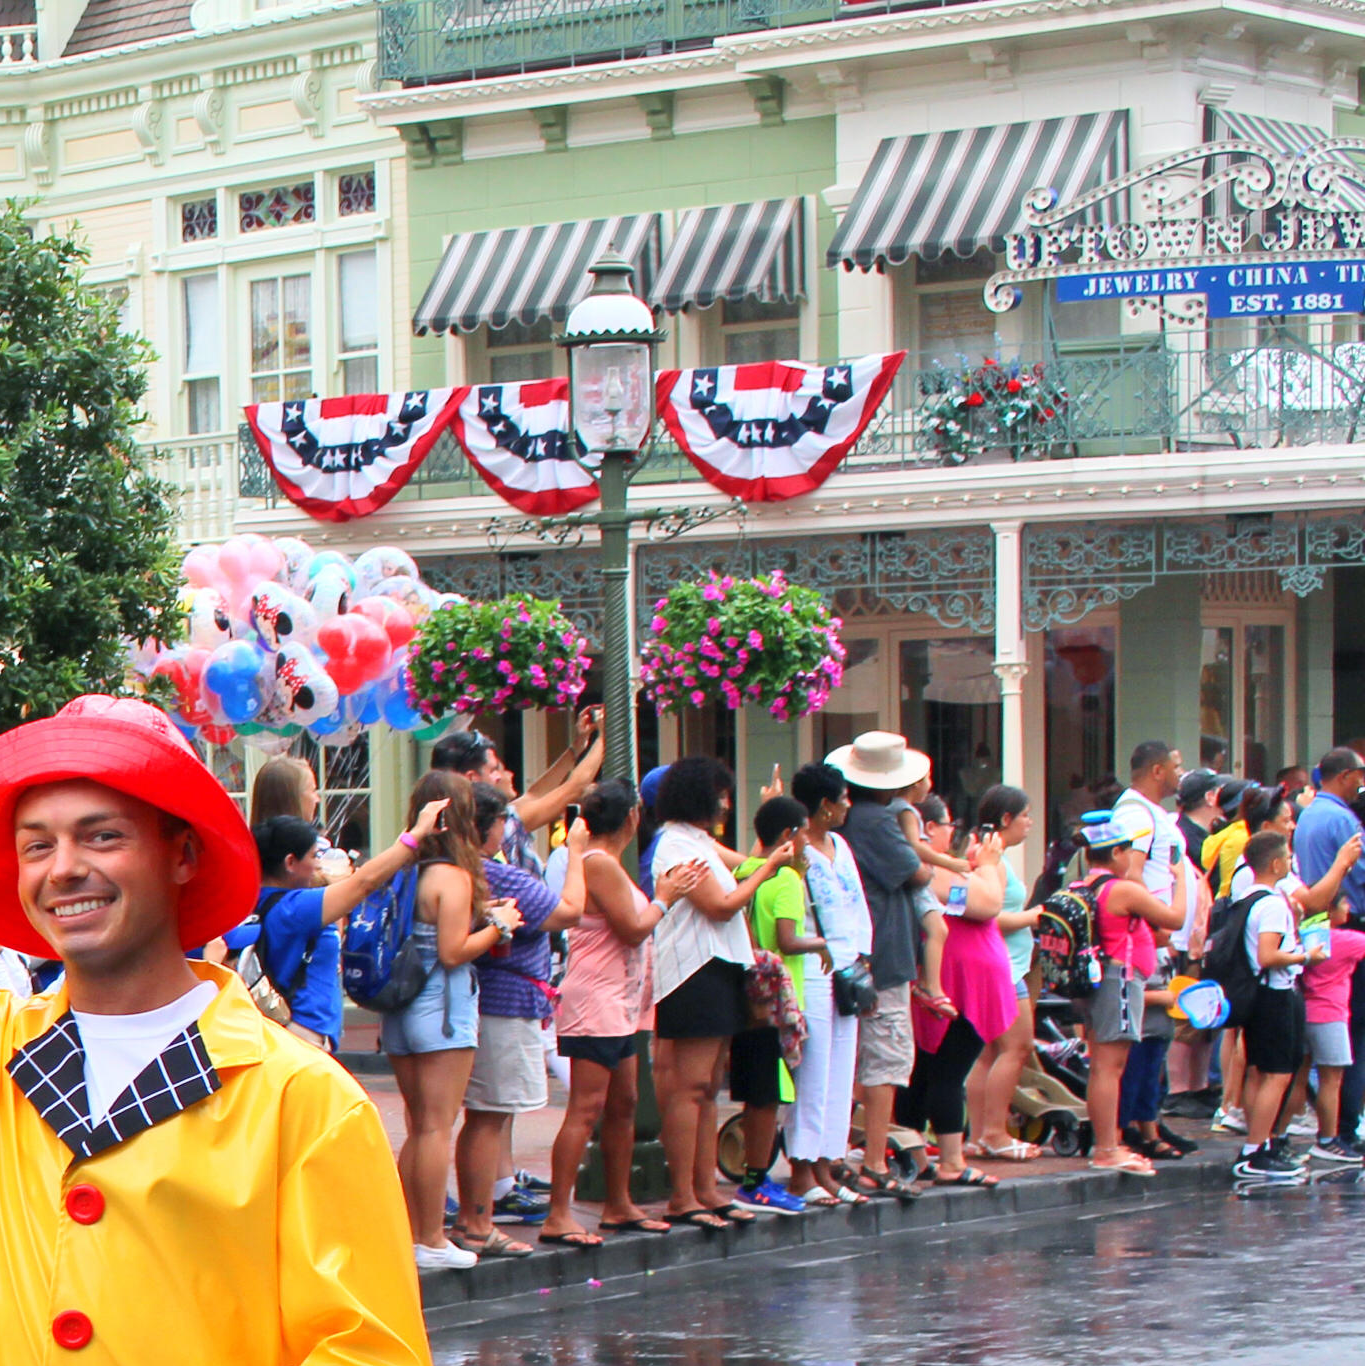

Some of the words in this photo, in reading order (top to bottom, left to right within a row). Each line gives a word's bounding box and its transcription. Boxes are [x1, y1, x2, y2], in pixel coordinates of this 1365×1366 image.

[1003, 214, 1246, 271] UPTOWN
[1083, 271, 1200, 297] JEWELRY
[1227, 266, 1309, 287] CHINA
[1230, 293, 1284, 313] EST.
[1290, 292, 1345, 311] 1881
